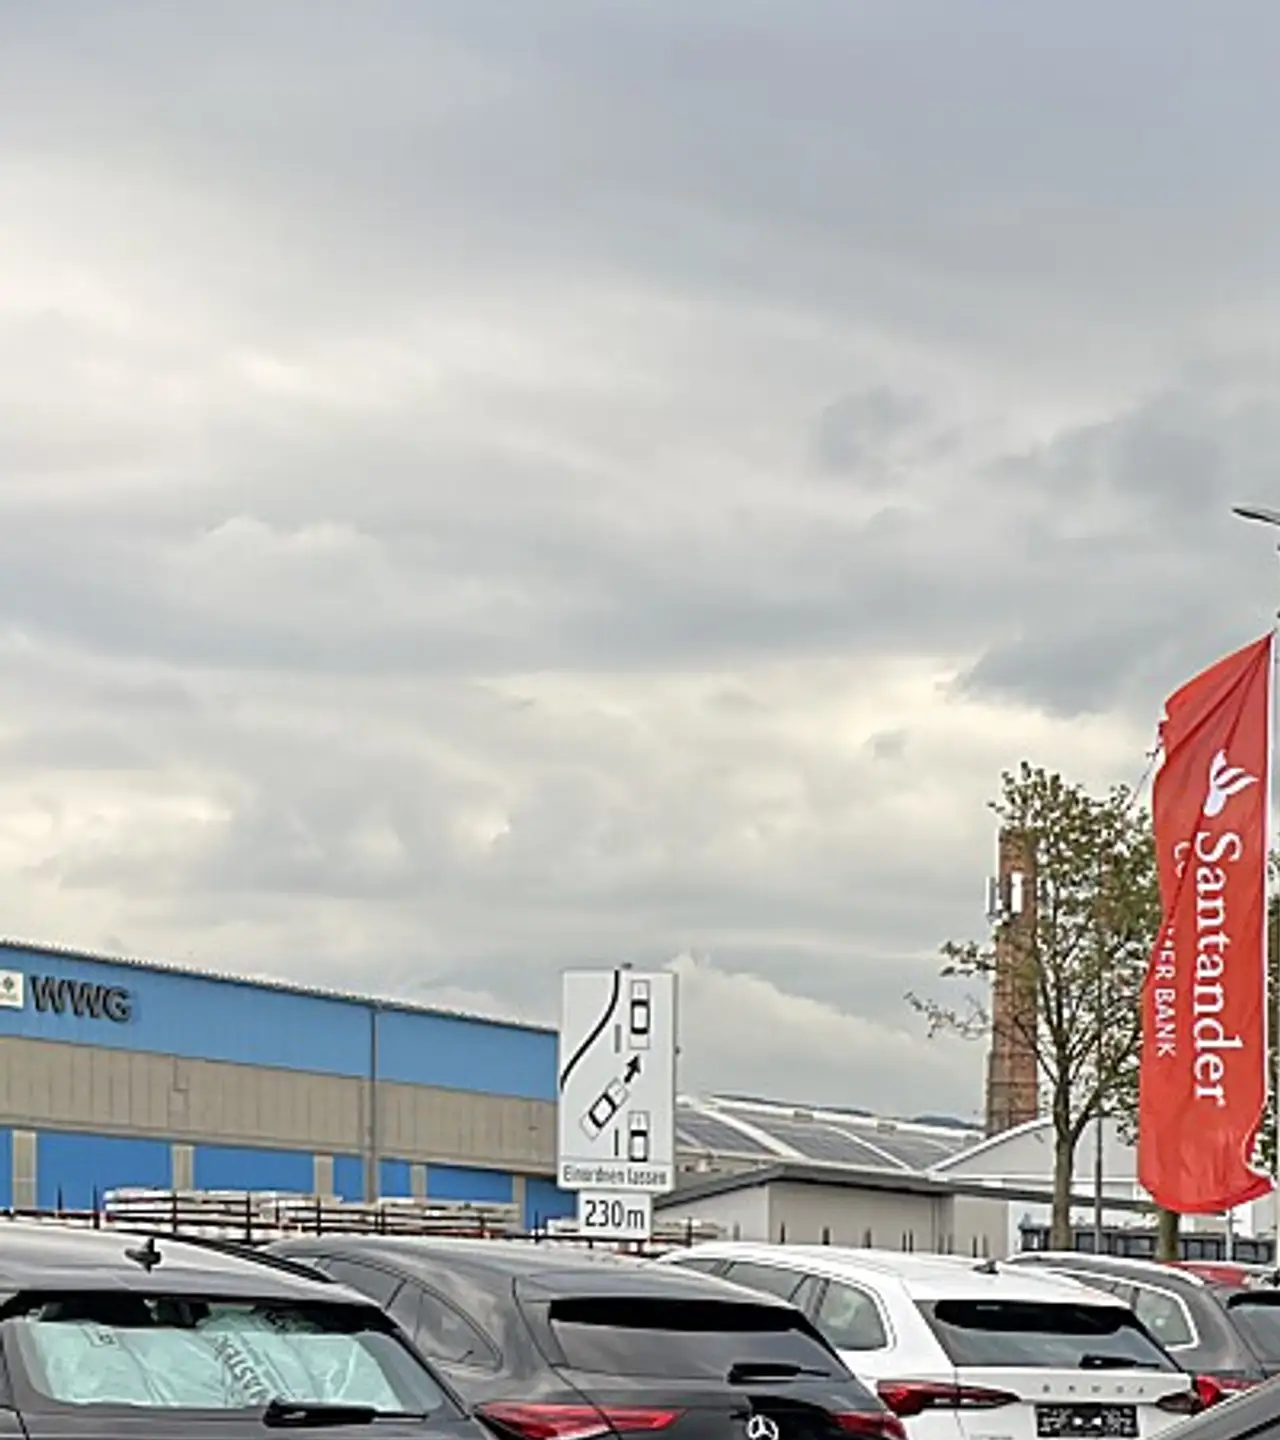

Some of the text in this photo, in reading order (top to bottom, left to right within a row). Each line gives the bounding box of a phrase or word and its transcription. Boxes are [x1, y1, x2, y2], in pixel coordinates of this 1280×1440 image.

[29, 975, 133, 1023] WWG
[1193, 831, 1243, 1108] Santander
[1154, 987, 1177, 1058] BANK
